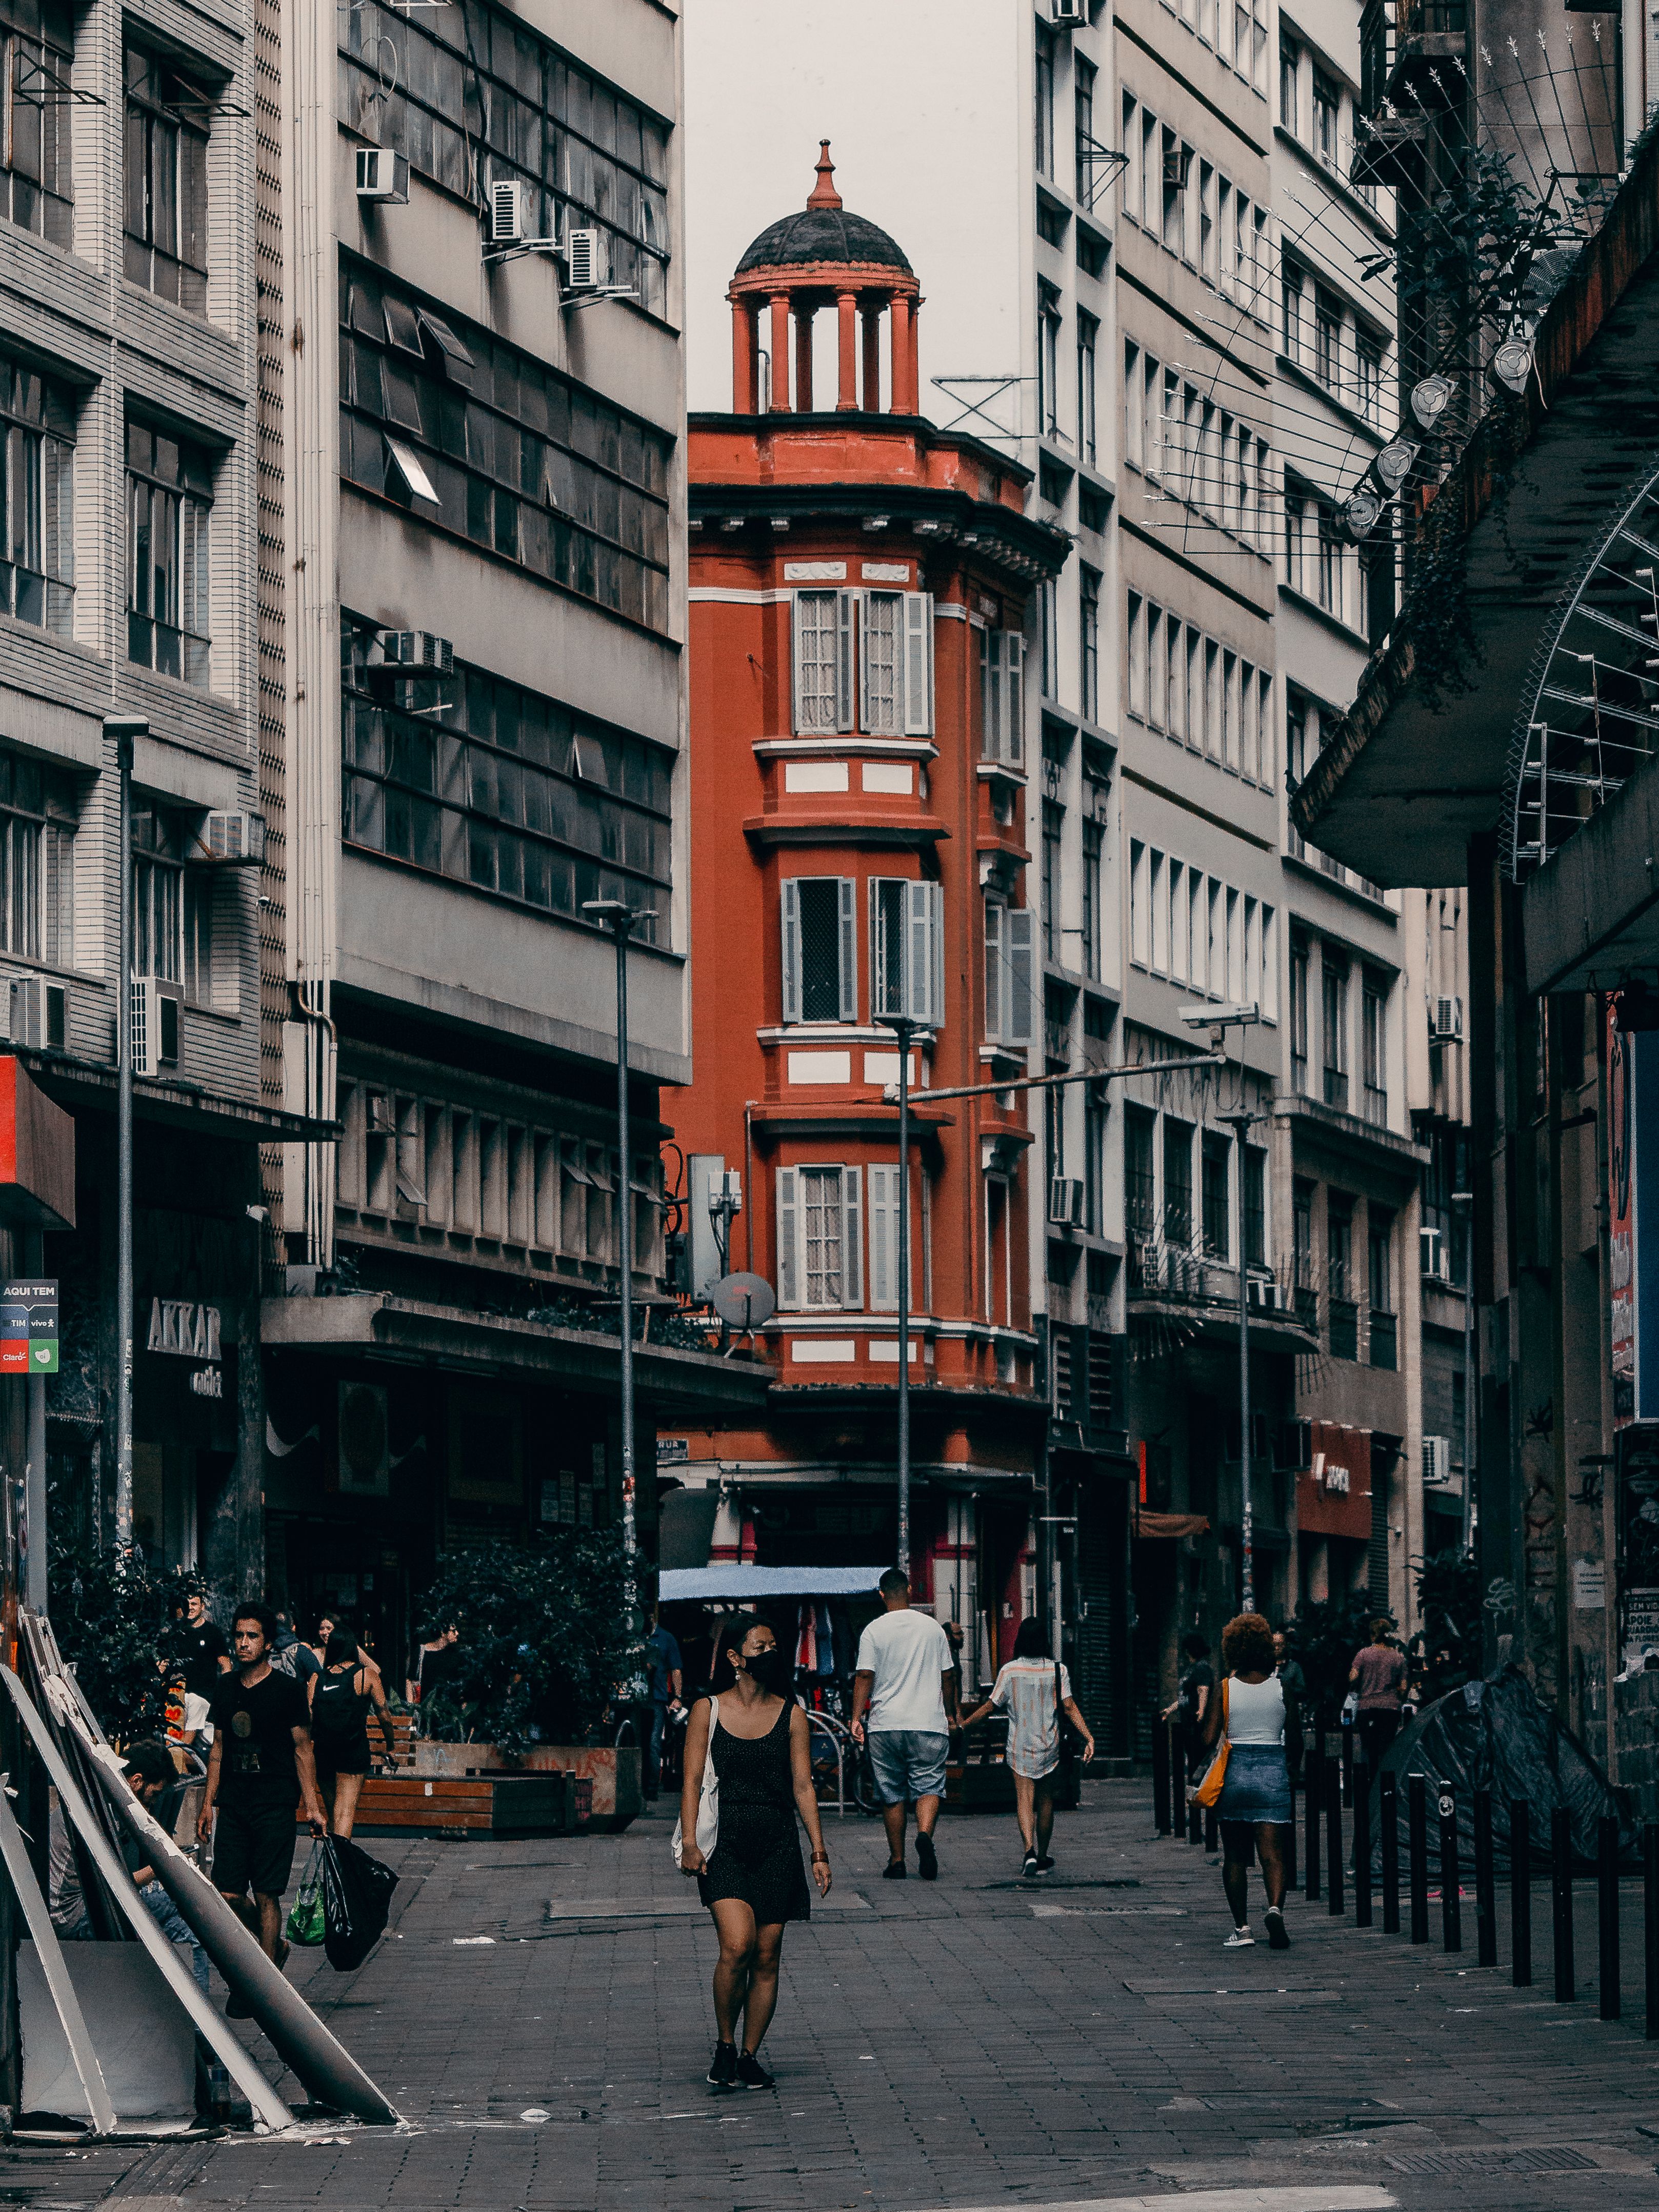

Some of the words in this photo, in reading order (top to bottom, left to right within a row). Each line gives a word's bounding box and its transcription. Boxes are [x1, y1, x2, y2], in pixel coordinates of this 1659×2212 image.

[3, 1287, 30, 1296] AQUI
[32, 1287, 54, 1296] TEM
[3, 1352, 25, 1361] Claro
[658, 1440, 678, 1448] RUA
[1629, 1602, 1644, 1610] SEM
[1646, 1602, 1659, 1610] VID
